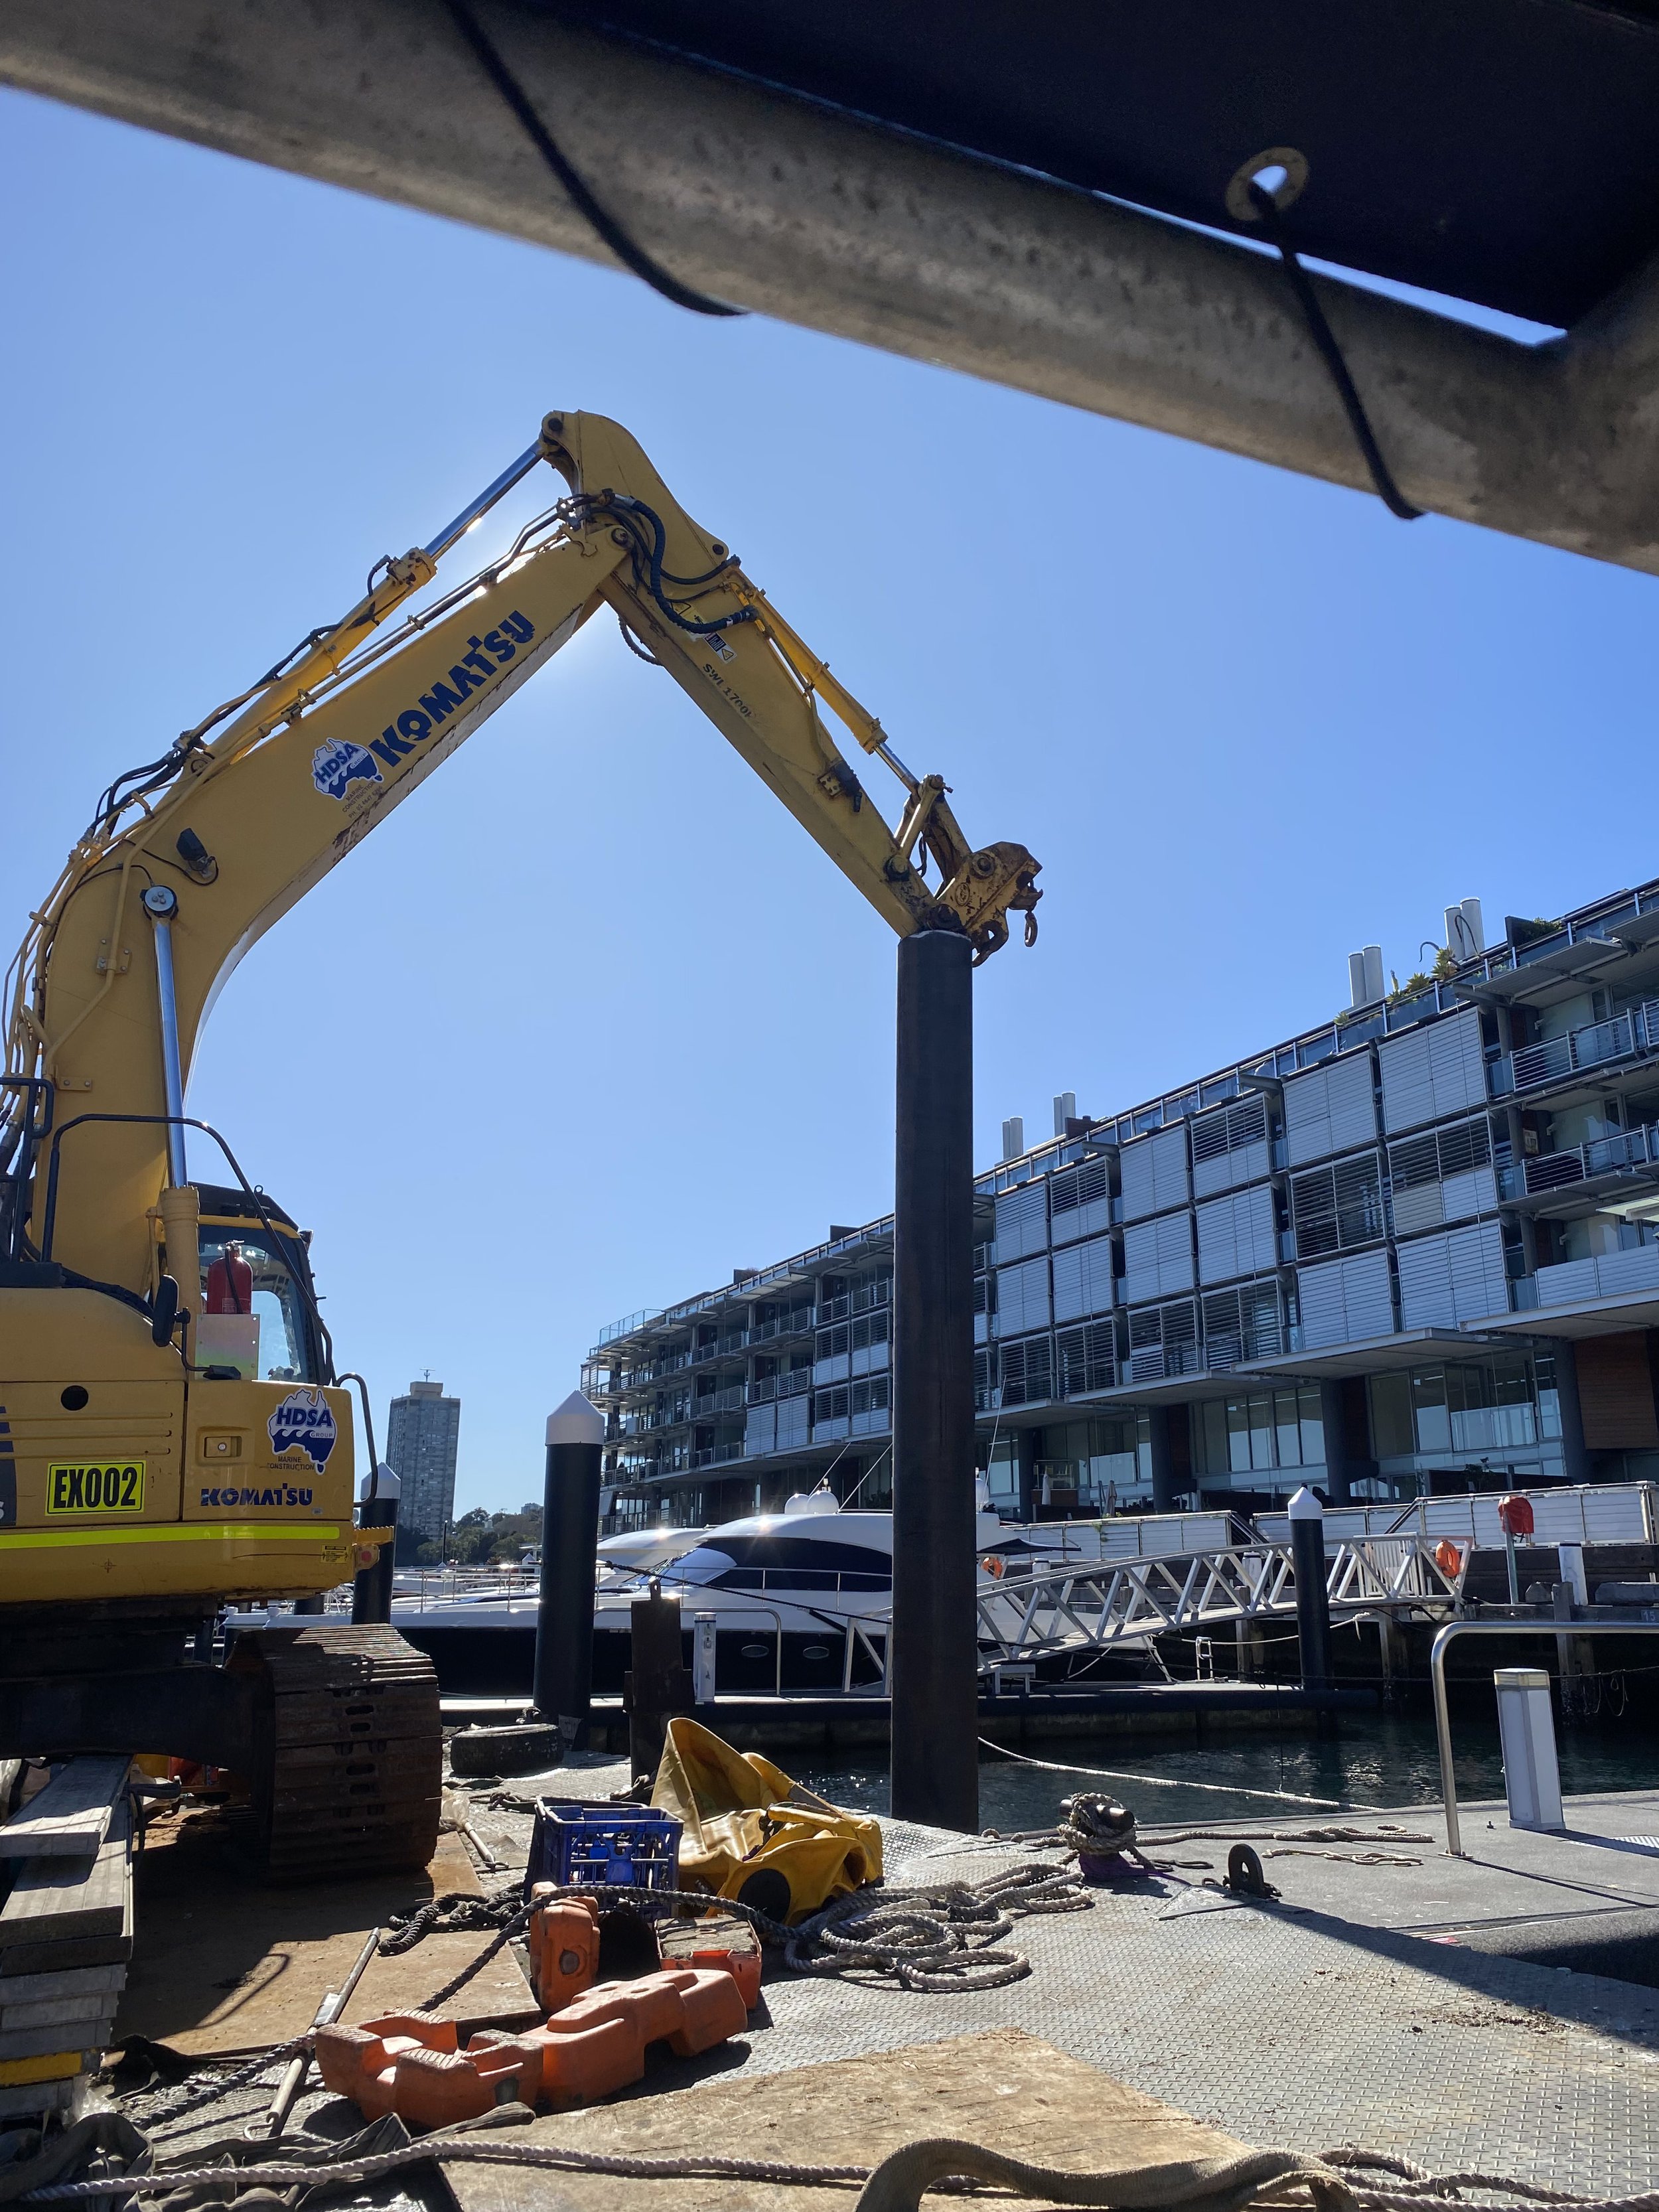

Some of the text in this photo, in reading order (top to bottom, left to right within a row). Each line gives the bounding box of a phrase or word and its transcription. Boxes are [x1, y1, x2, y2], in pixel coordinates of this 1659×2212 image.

[368, 610, 536, 768] KOMATSU
[313, 743, 359, 784] HDSA
[351, 753, 368, 768] GROUP
[342, 781, 376, 812] CONSTRUCTION
[346, 784, 364, 802] MARINE
[276, 1406, 332, 1427] HDSA
[53, 1467, 137, 1509] EX002
[200, 1483, 313, 1507] KOMATSU
